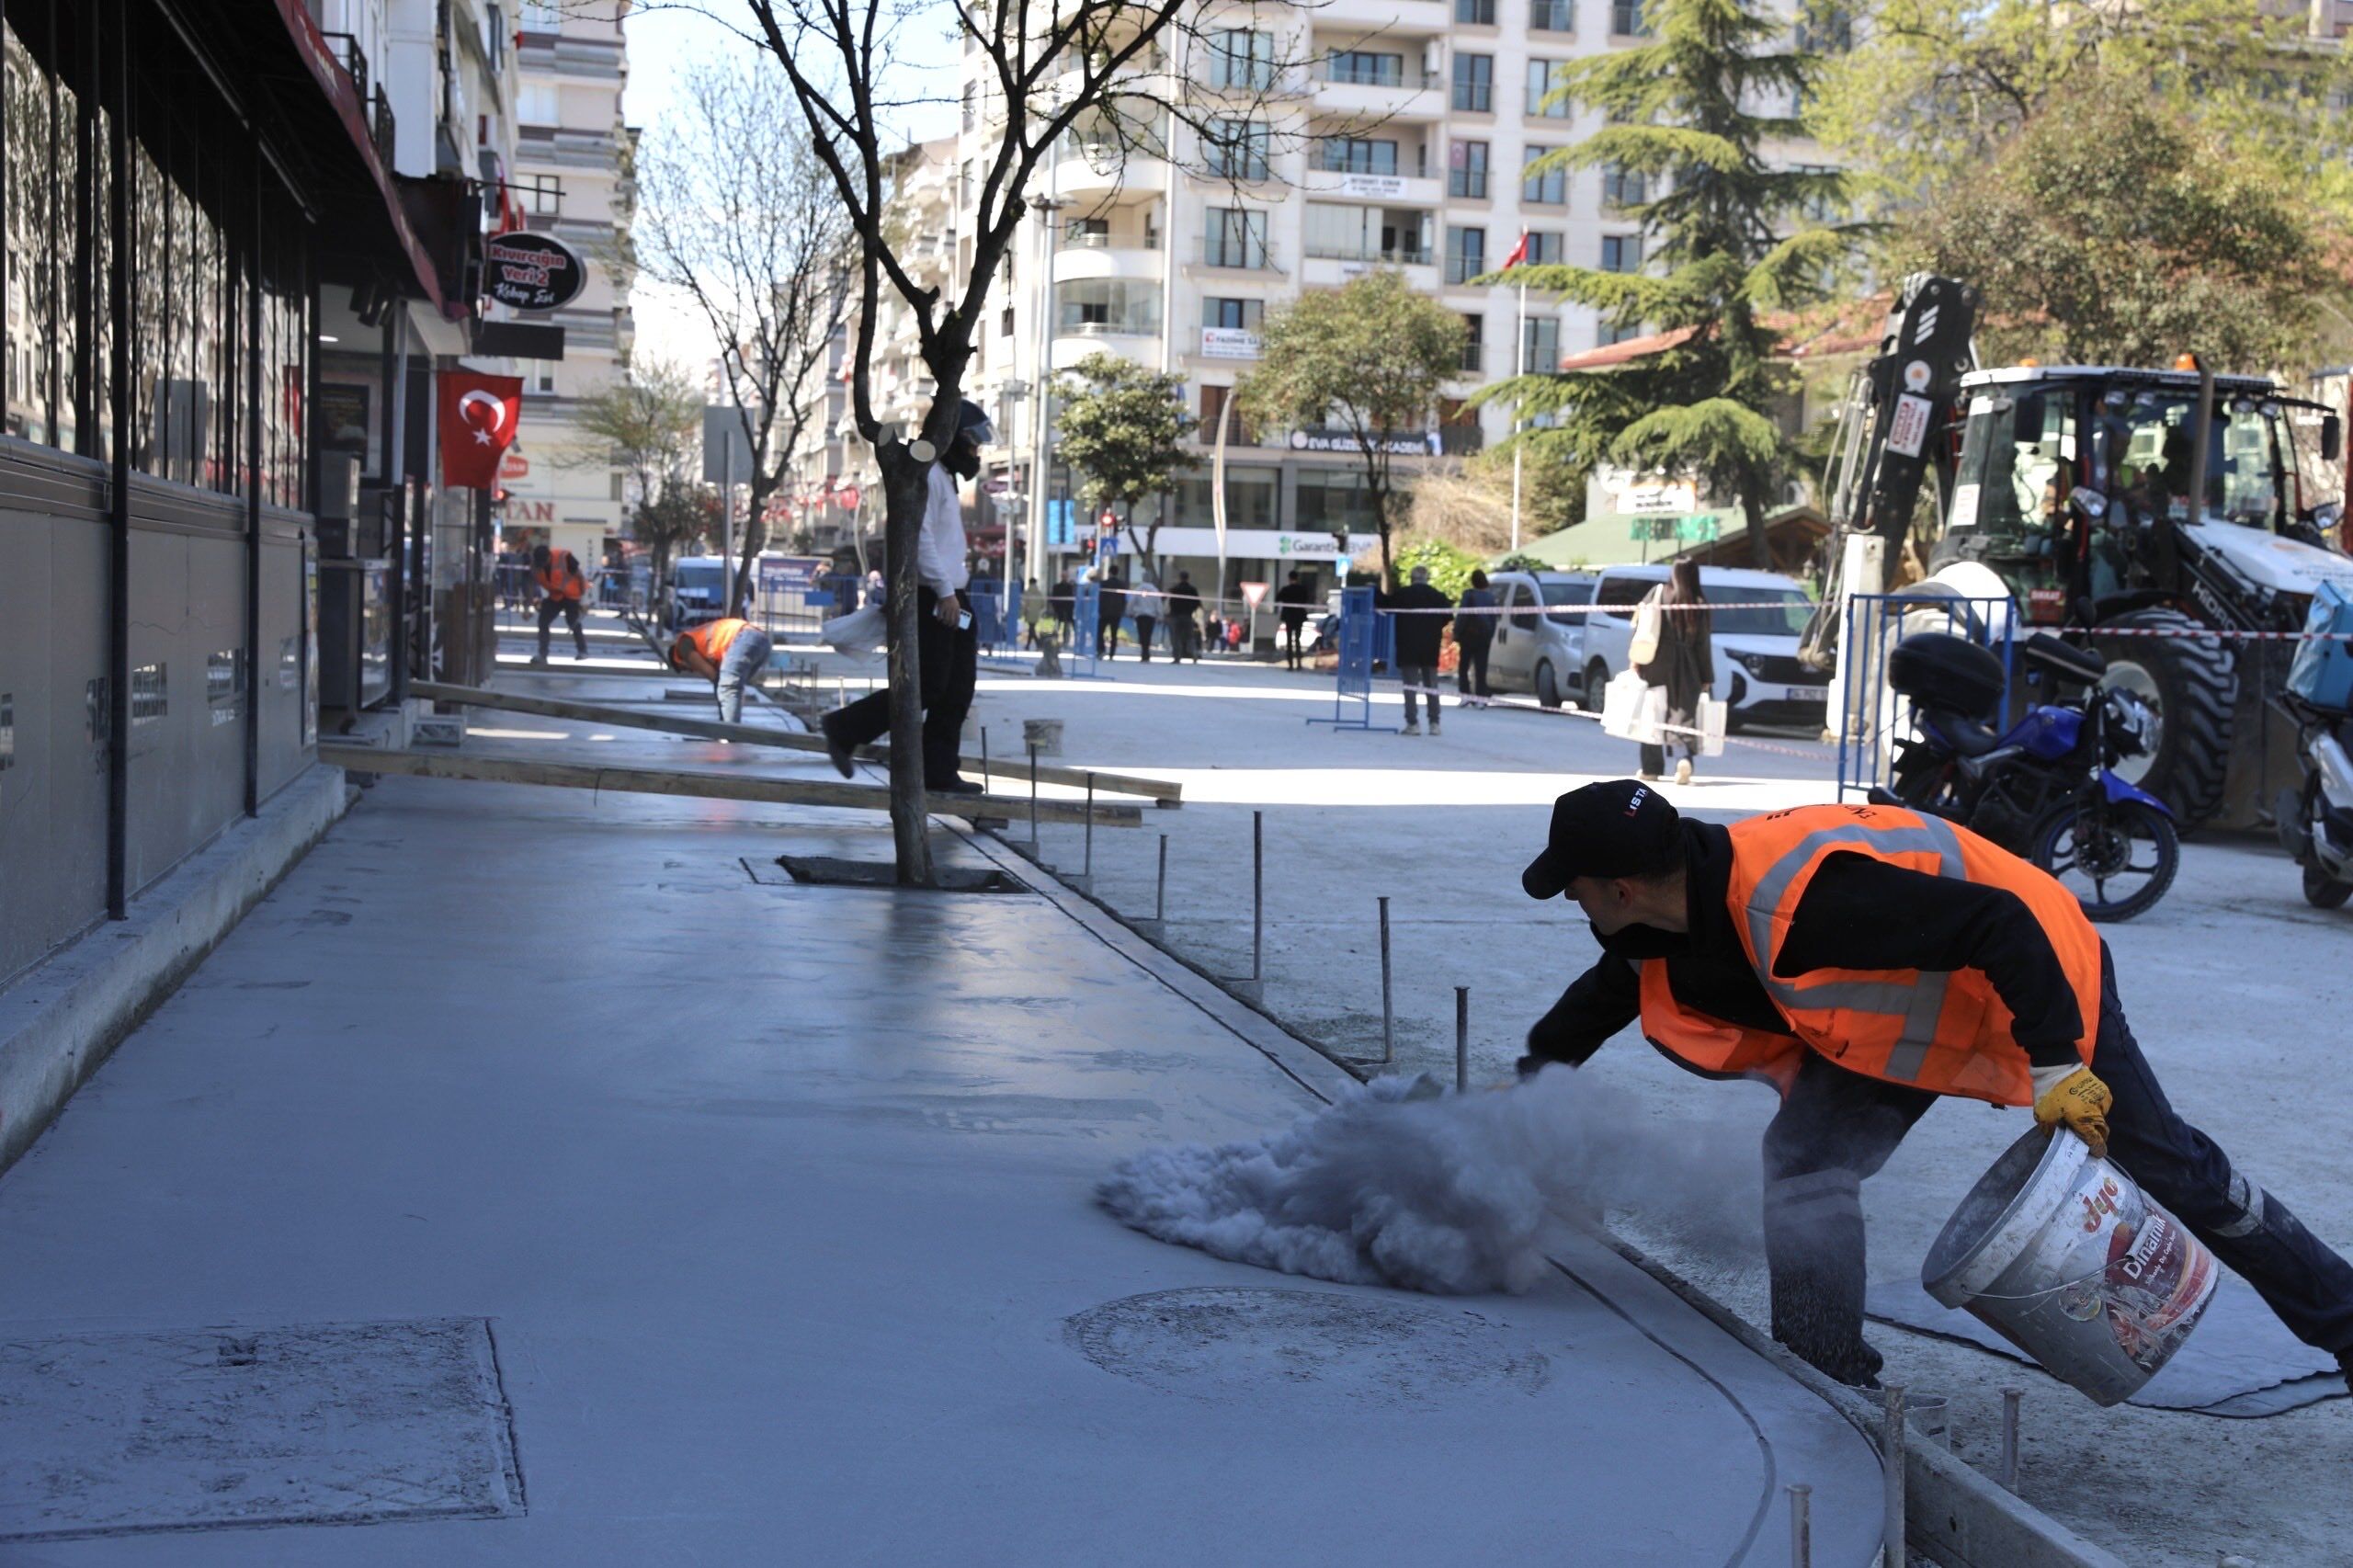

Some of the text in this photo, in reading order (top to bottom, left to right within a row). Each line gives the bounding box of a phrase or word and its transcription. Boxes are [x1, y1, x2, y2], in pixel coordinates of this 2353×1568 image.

[535, 268, 550, 287] 2
[2083, 1176, 2119, 1233] dyo
[2122, 1213, 2166, 1279] Dinamik
